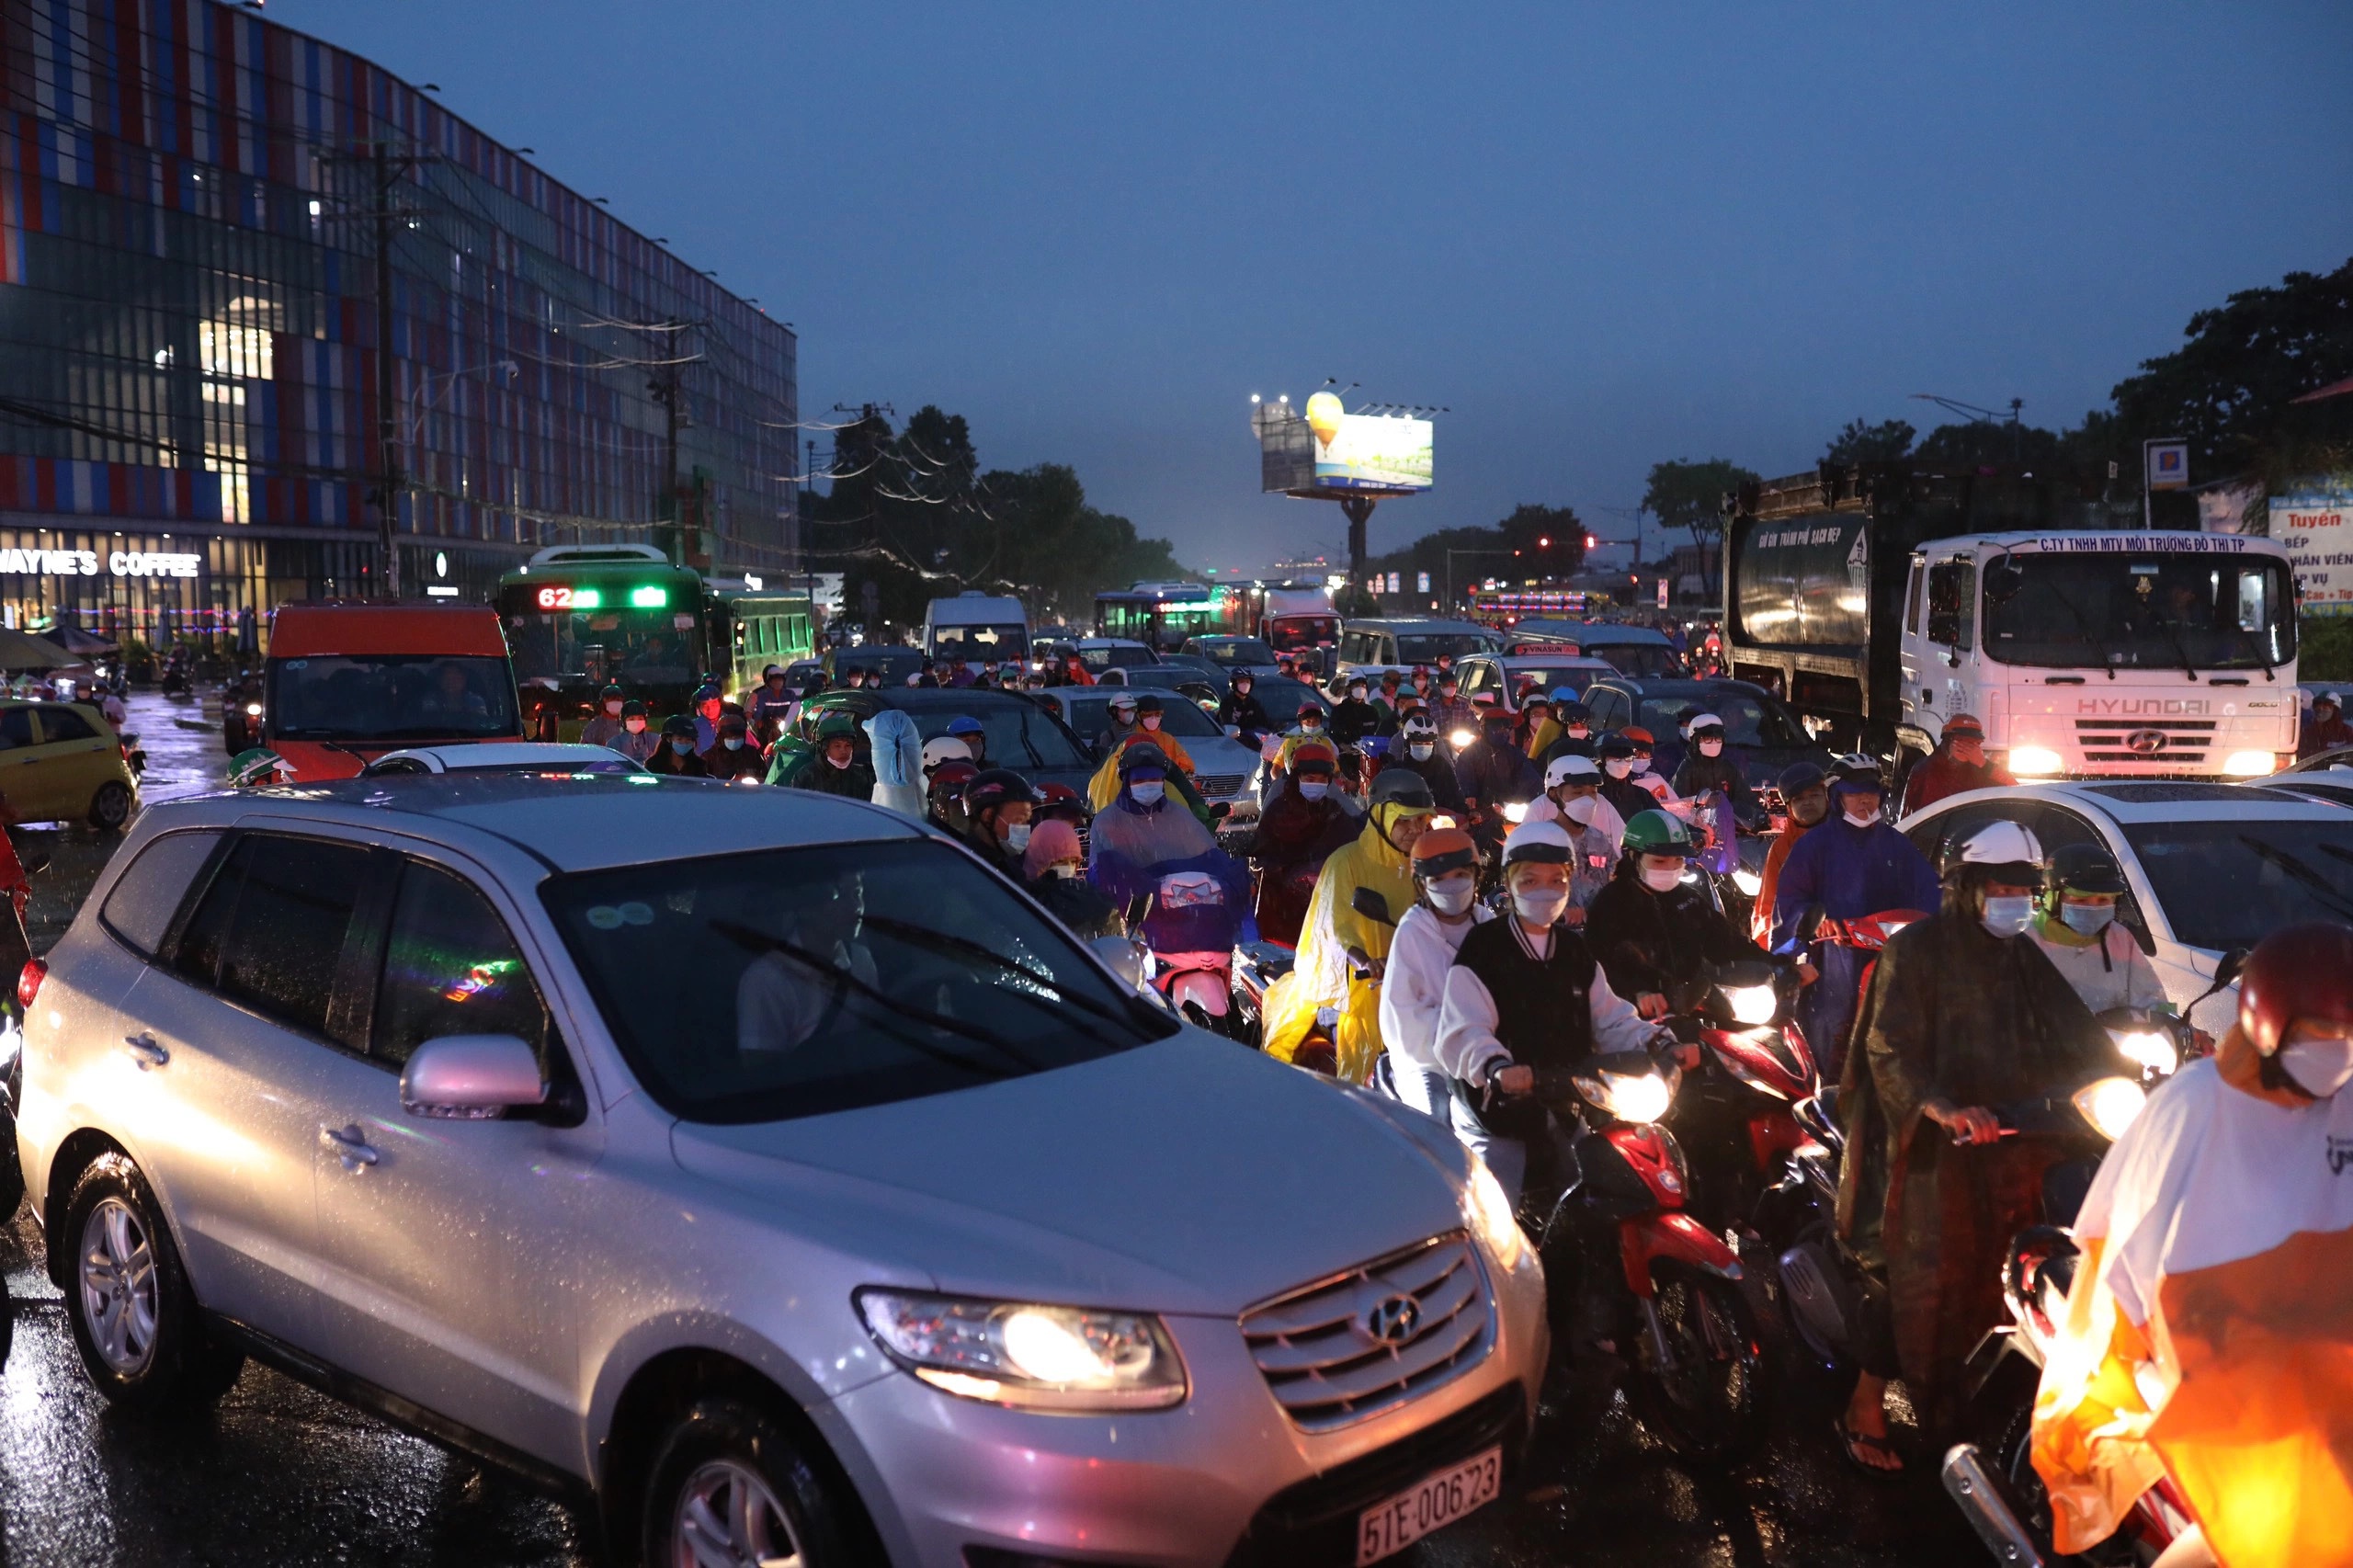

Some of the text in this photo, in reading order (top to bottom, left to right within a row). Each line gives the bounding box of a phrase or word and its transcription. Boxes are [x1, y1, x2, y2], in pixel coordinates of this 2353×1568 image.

[2068, 538, 2097, 551] TNHH
[2100, 538, 2122, 551] MTV
[2126, 535, 2146, 551] MÔI
[2194, 535, 2208, 551] ĐÔ
[2231, 539, 2245, 551] TP
[109, 551, 201, 577] COFFEE
[2078, 699, 2210, 714] HYUNDAI
